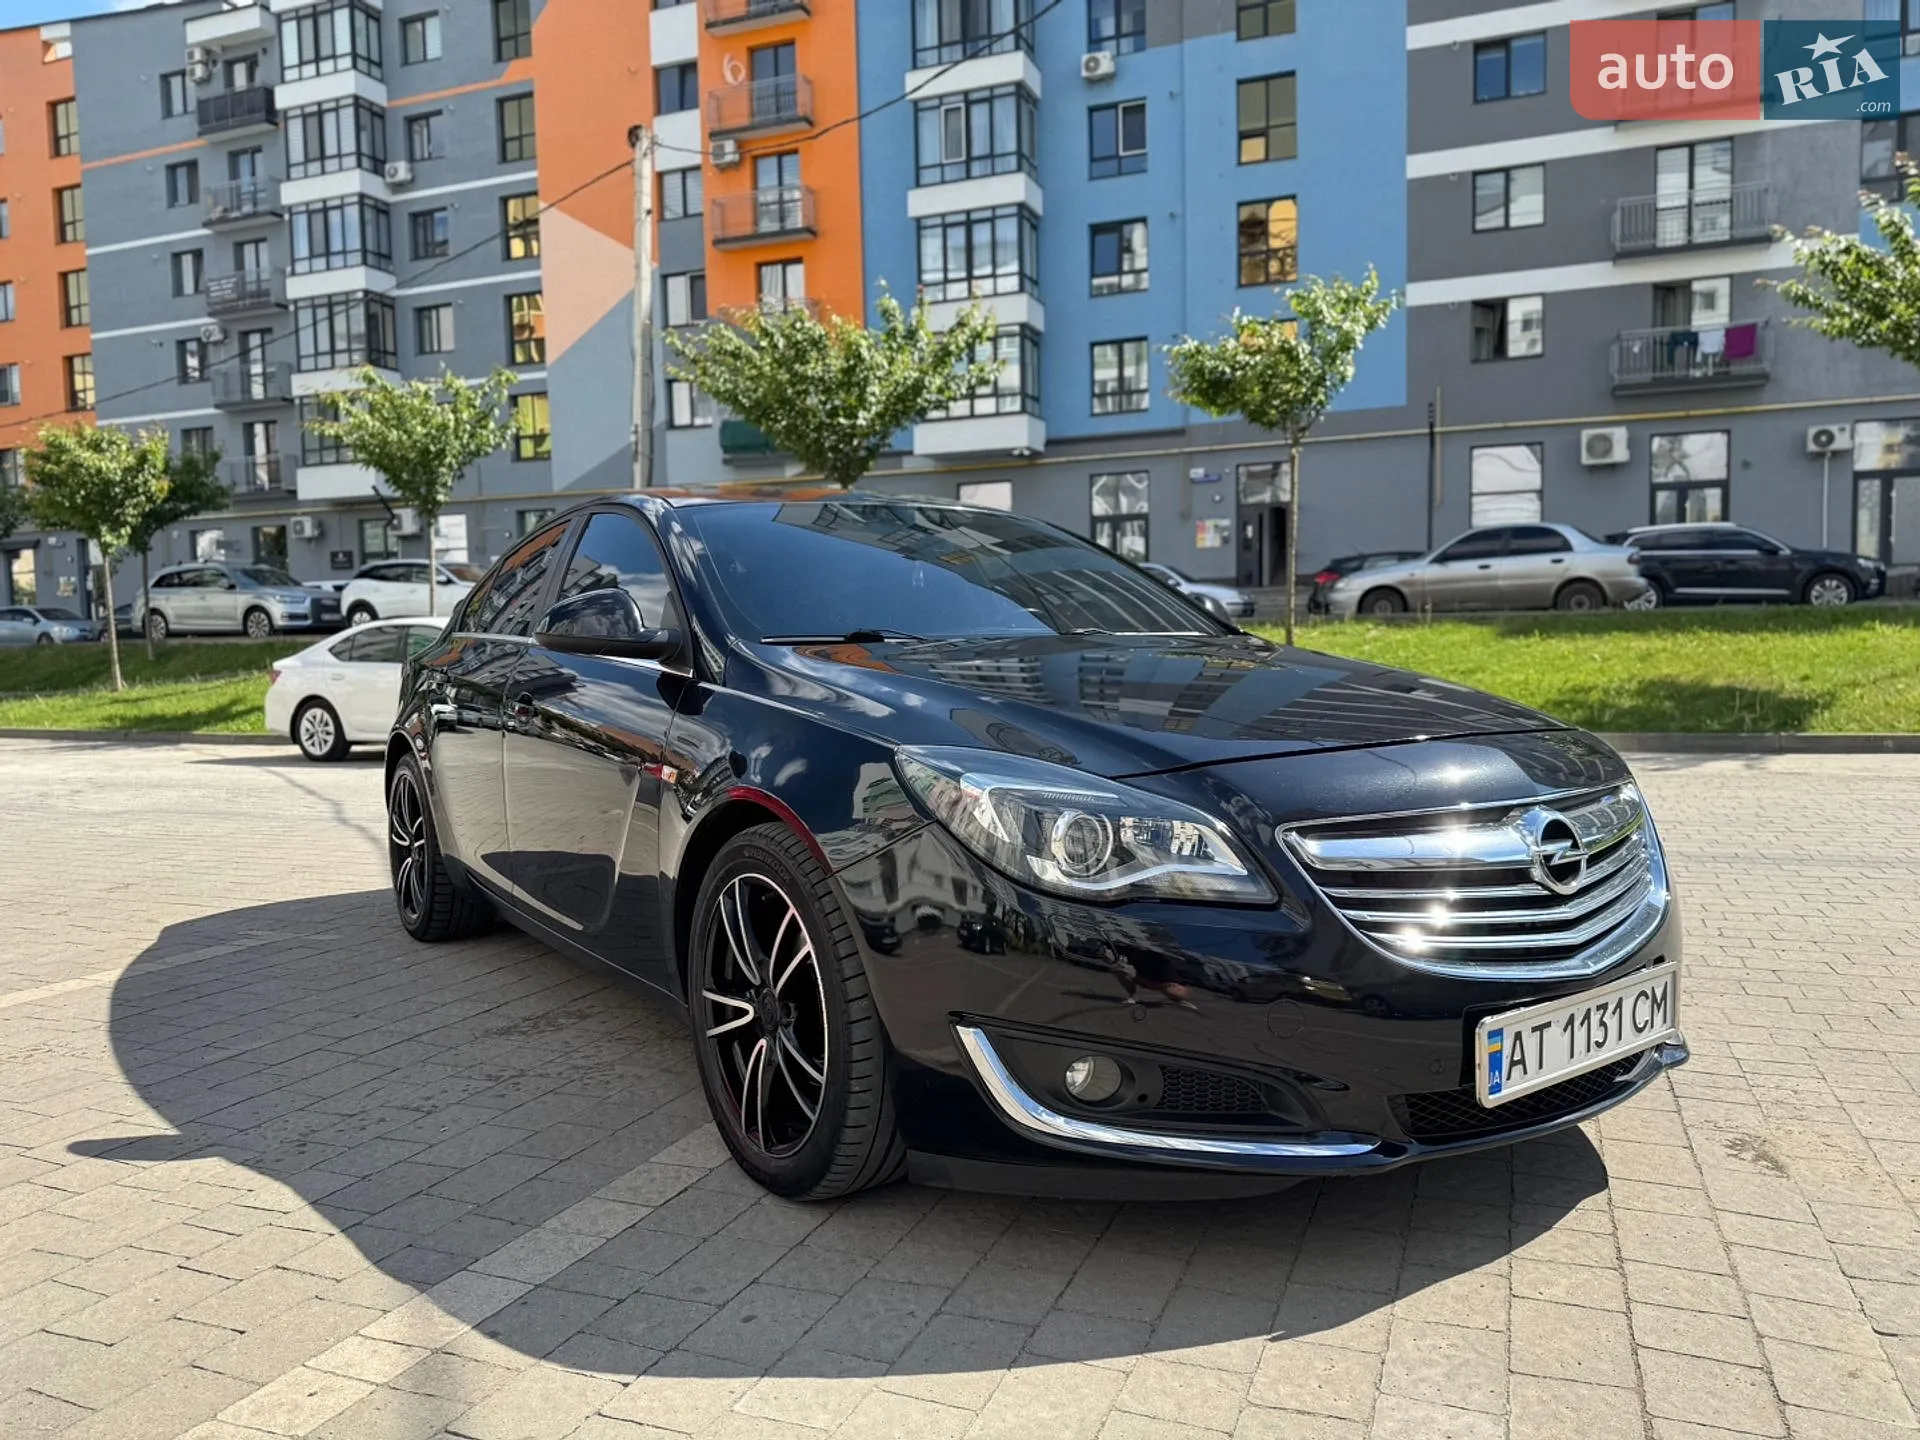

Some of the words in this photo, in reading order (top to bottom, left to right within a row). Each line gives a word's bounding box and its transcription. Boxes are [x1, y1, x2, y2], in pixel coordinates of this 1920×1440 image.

[1506, 1021, 1552, 1081] AT
[1563, 996, 1623, 1060] 1131
[1632, 981, 1668, 1034] CM
